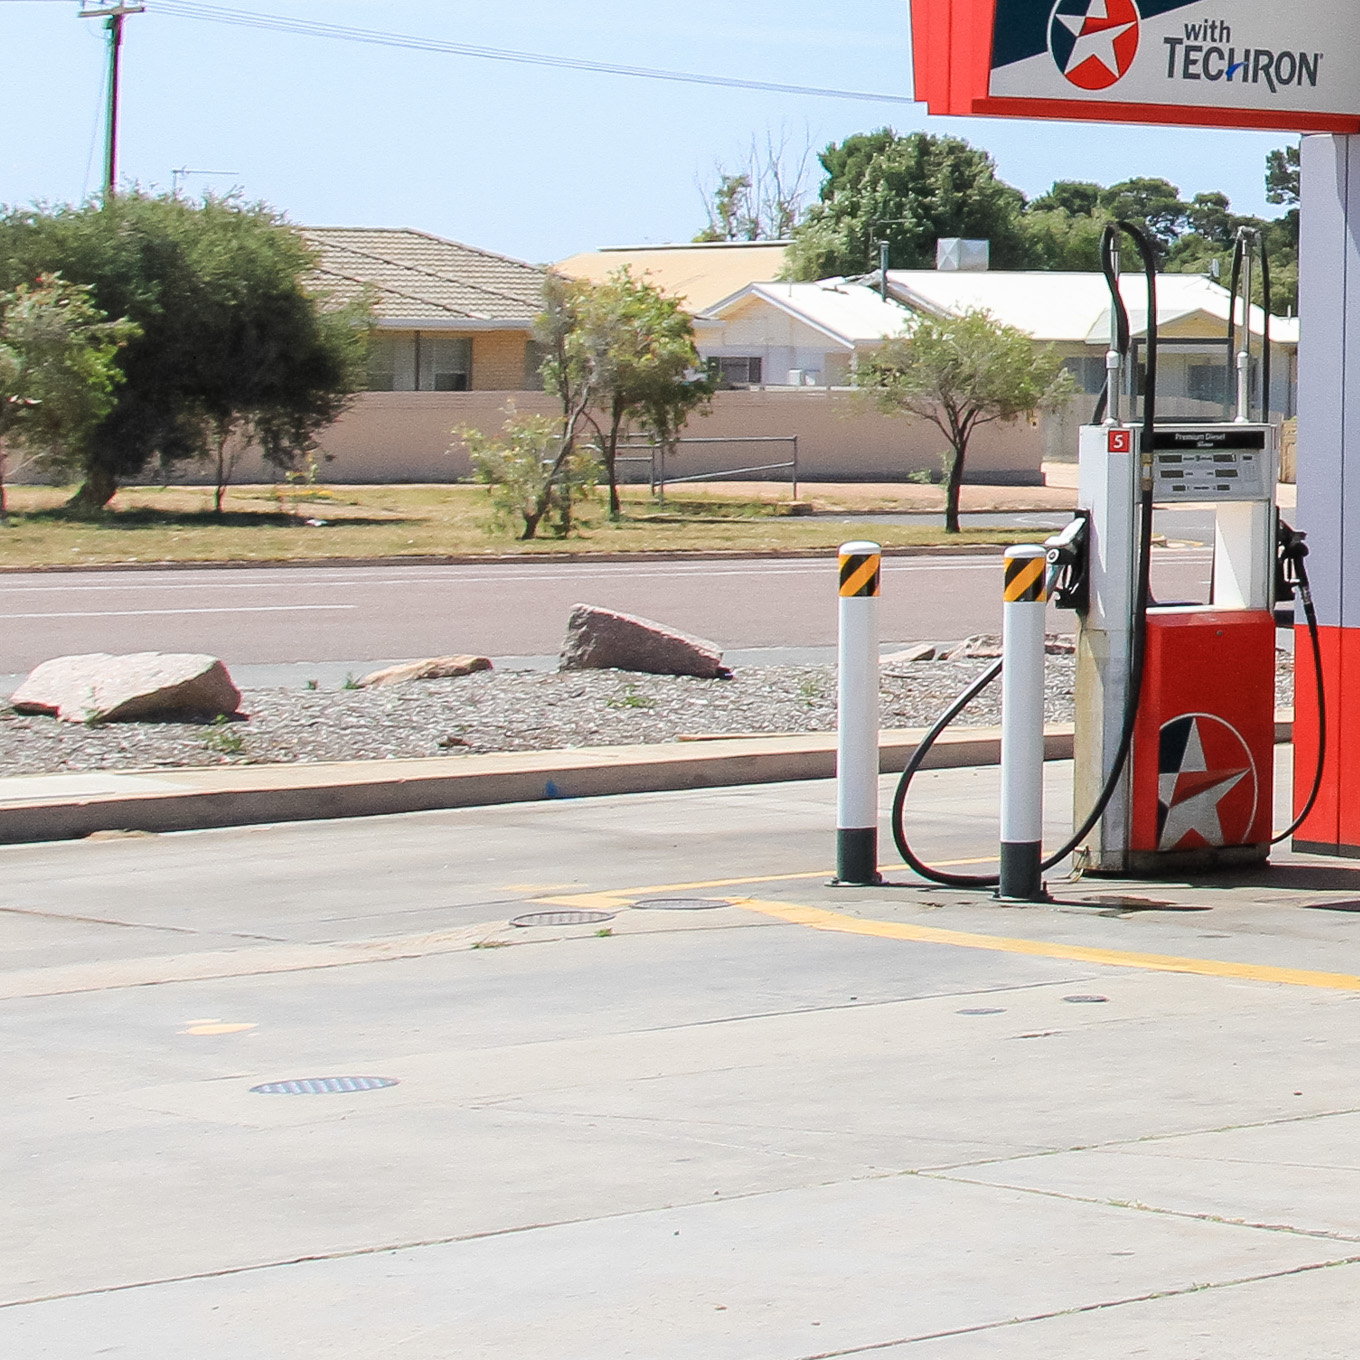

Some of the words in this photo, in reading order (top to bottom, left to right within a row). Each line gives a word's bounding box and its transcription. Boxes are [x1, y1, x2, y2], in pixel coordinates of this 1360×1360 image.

[1183, 18, 1232, 45] with
[1162, 36, 1321, 94] TECHRON
[1112, 433, 1124, 449] 5
